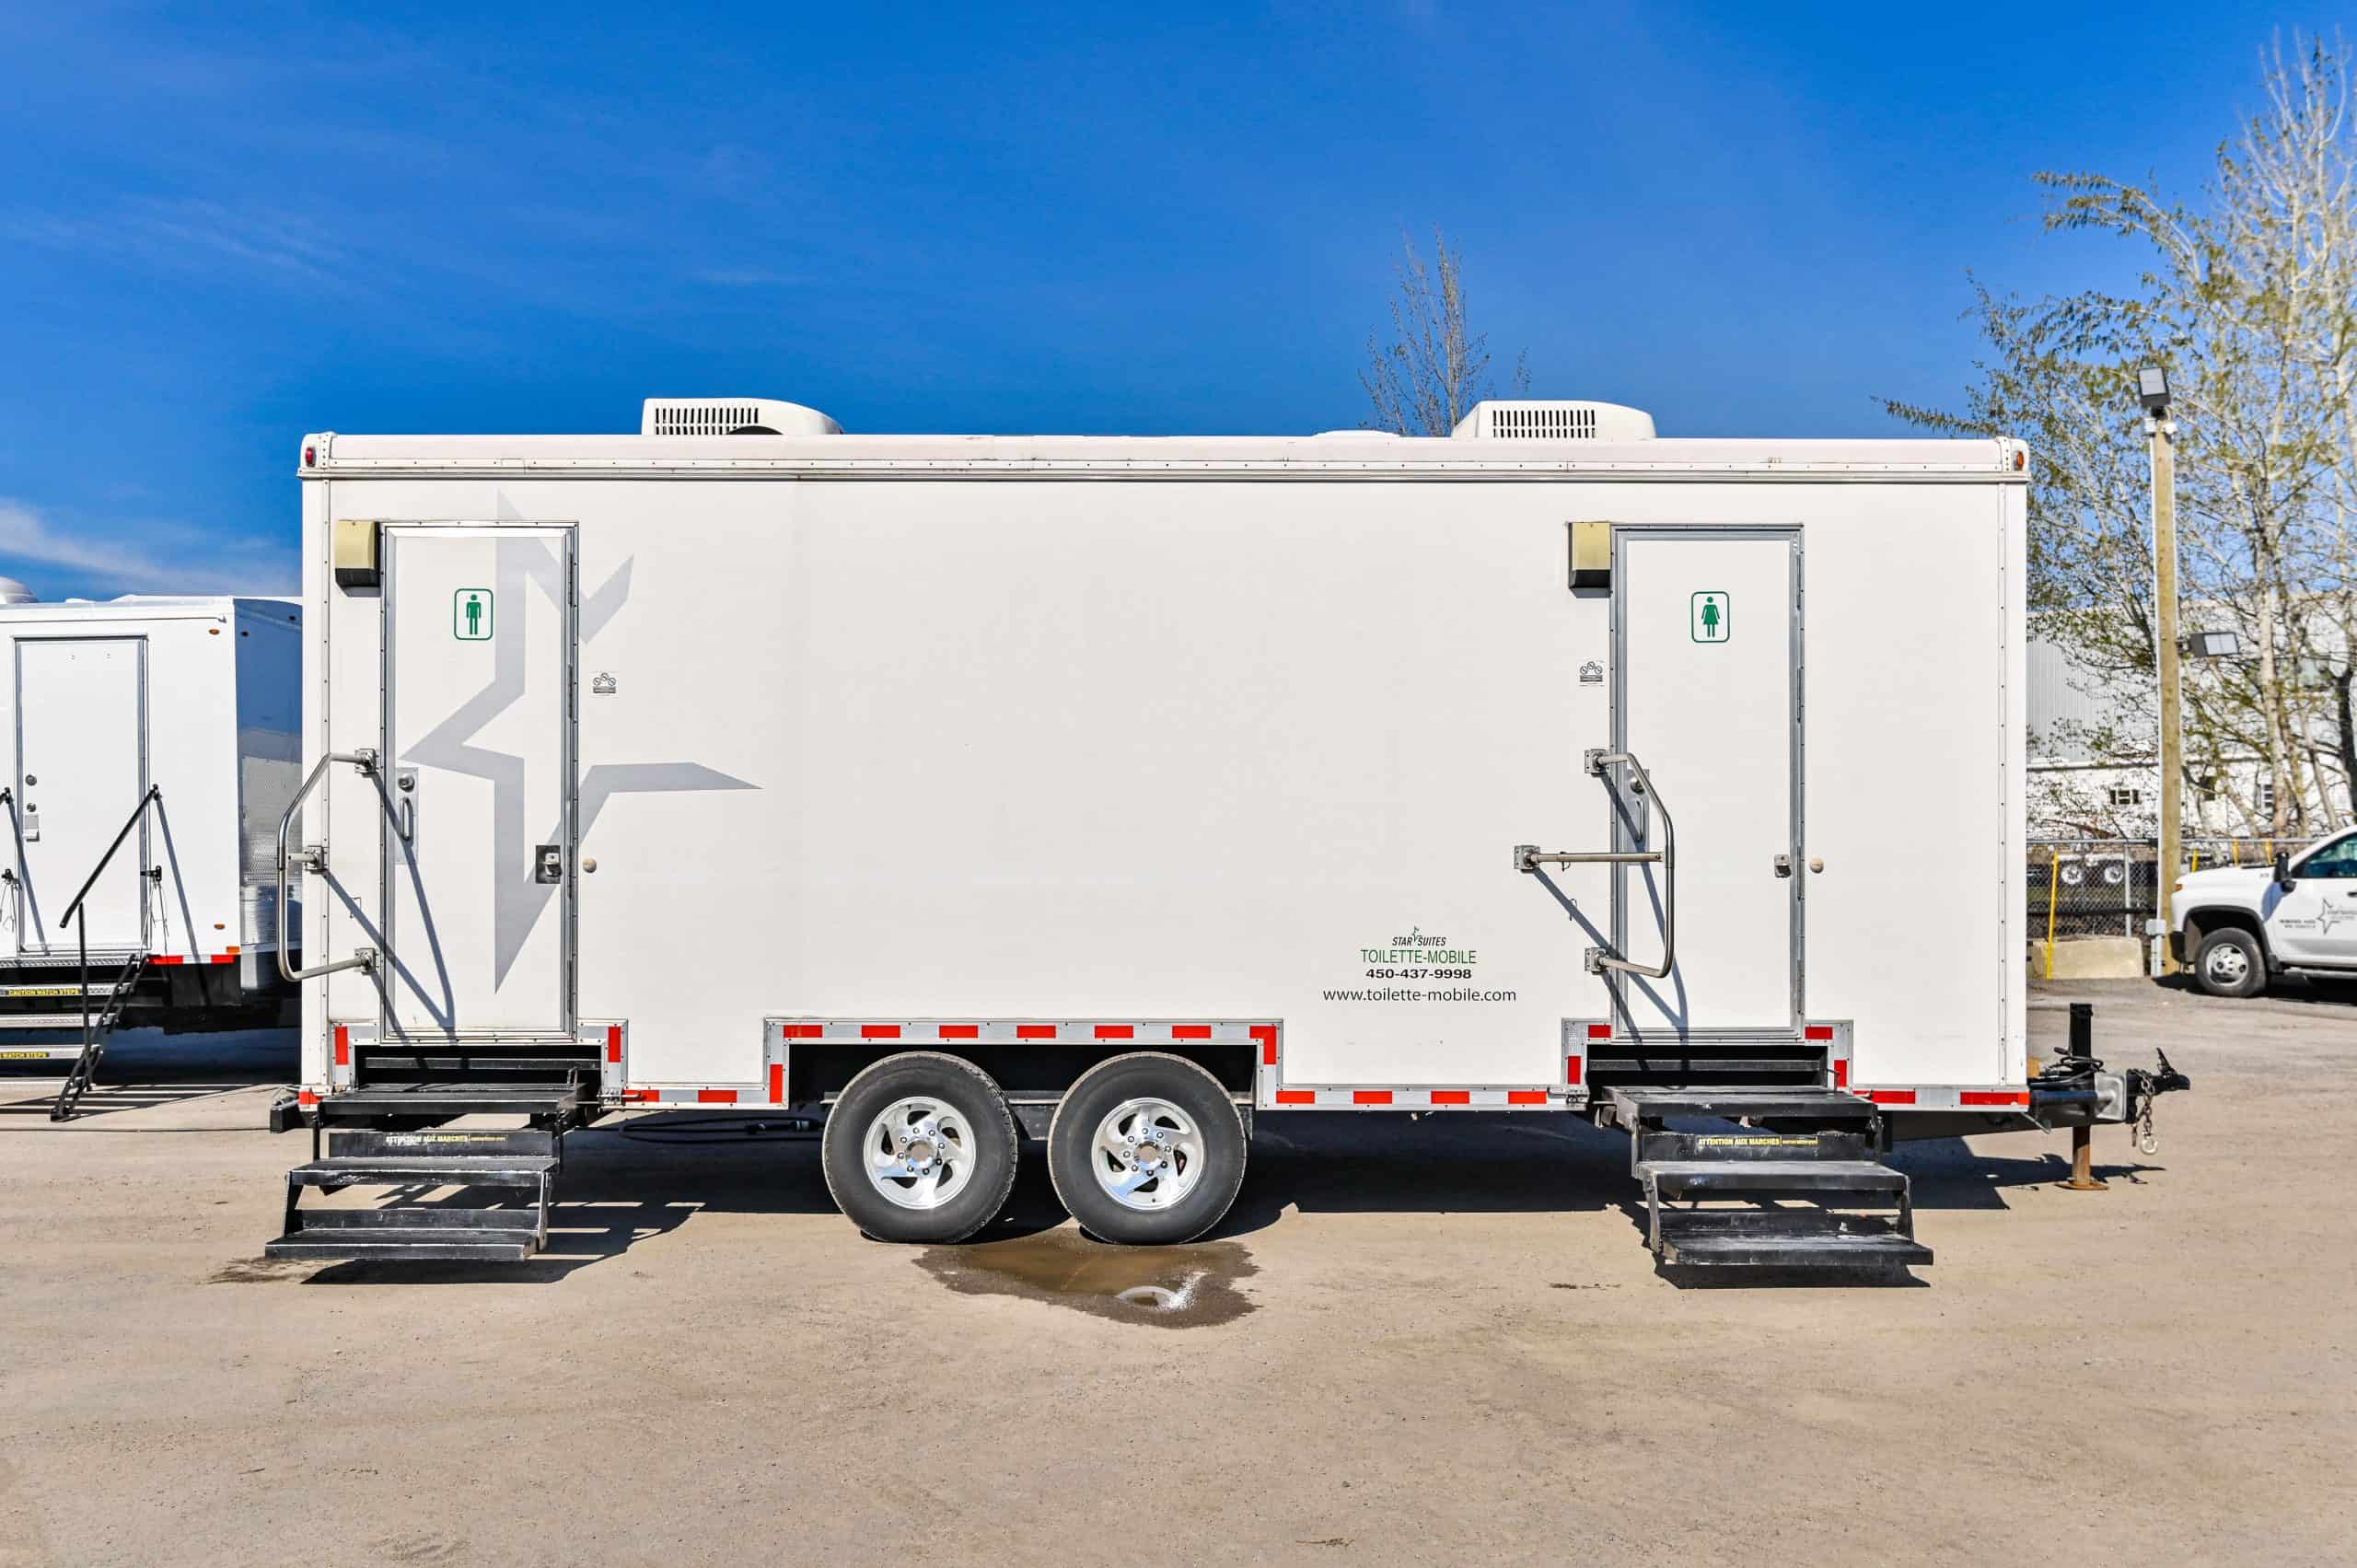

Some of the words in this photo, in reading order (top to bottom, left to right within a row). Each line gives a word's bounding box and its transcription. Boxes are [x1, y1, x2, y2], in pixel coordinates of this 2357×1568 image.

[1392, 936, 1413, 947] STAR
[1417, 936, 1446, 947] SUITES
[1360, 949, 1477, 964] TOILETTE-MOBILE
[1365, 969, 1472, 980] 450-437-9998
[1323, 987, 1517, 1002] www.toilette-mobile.com
